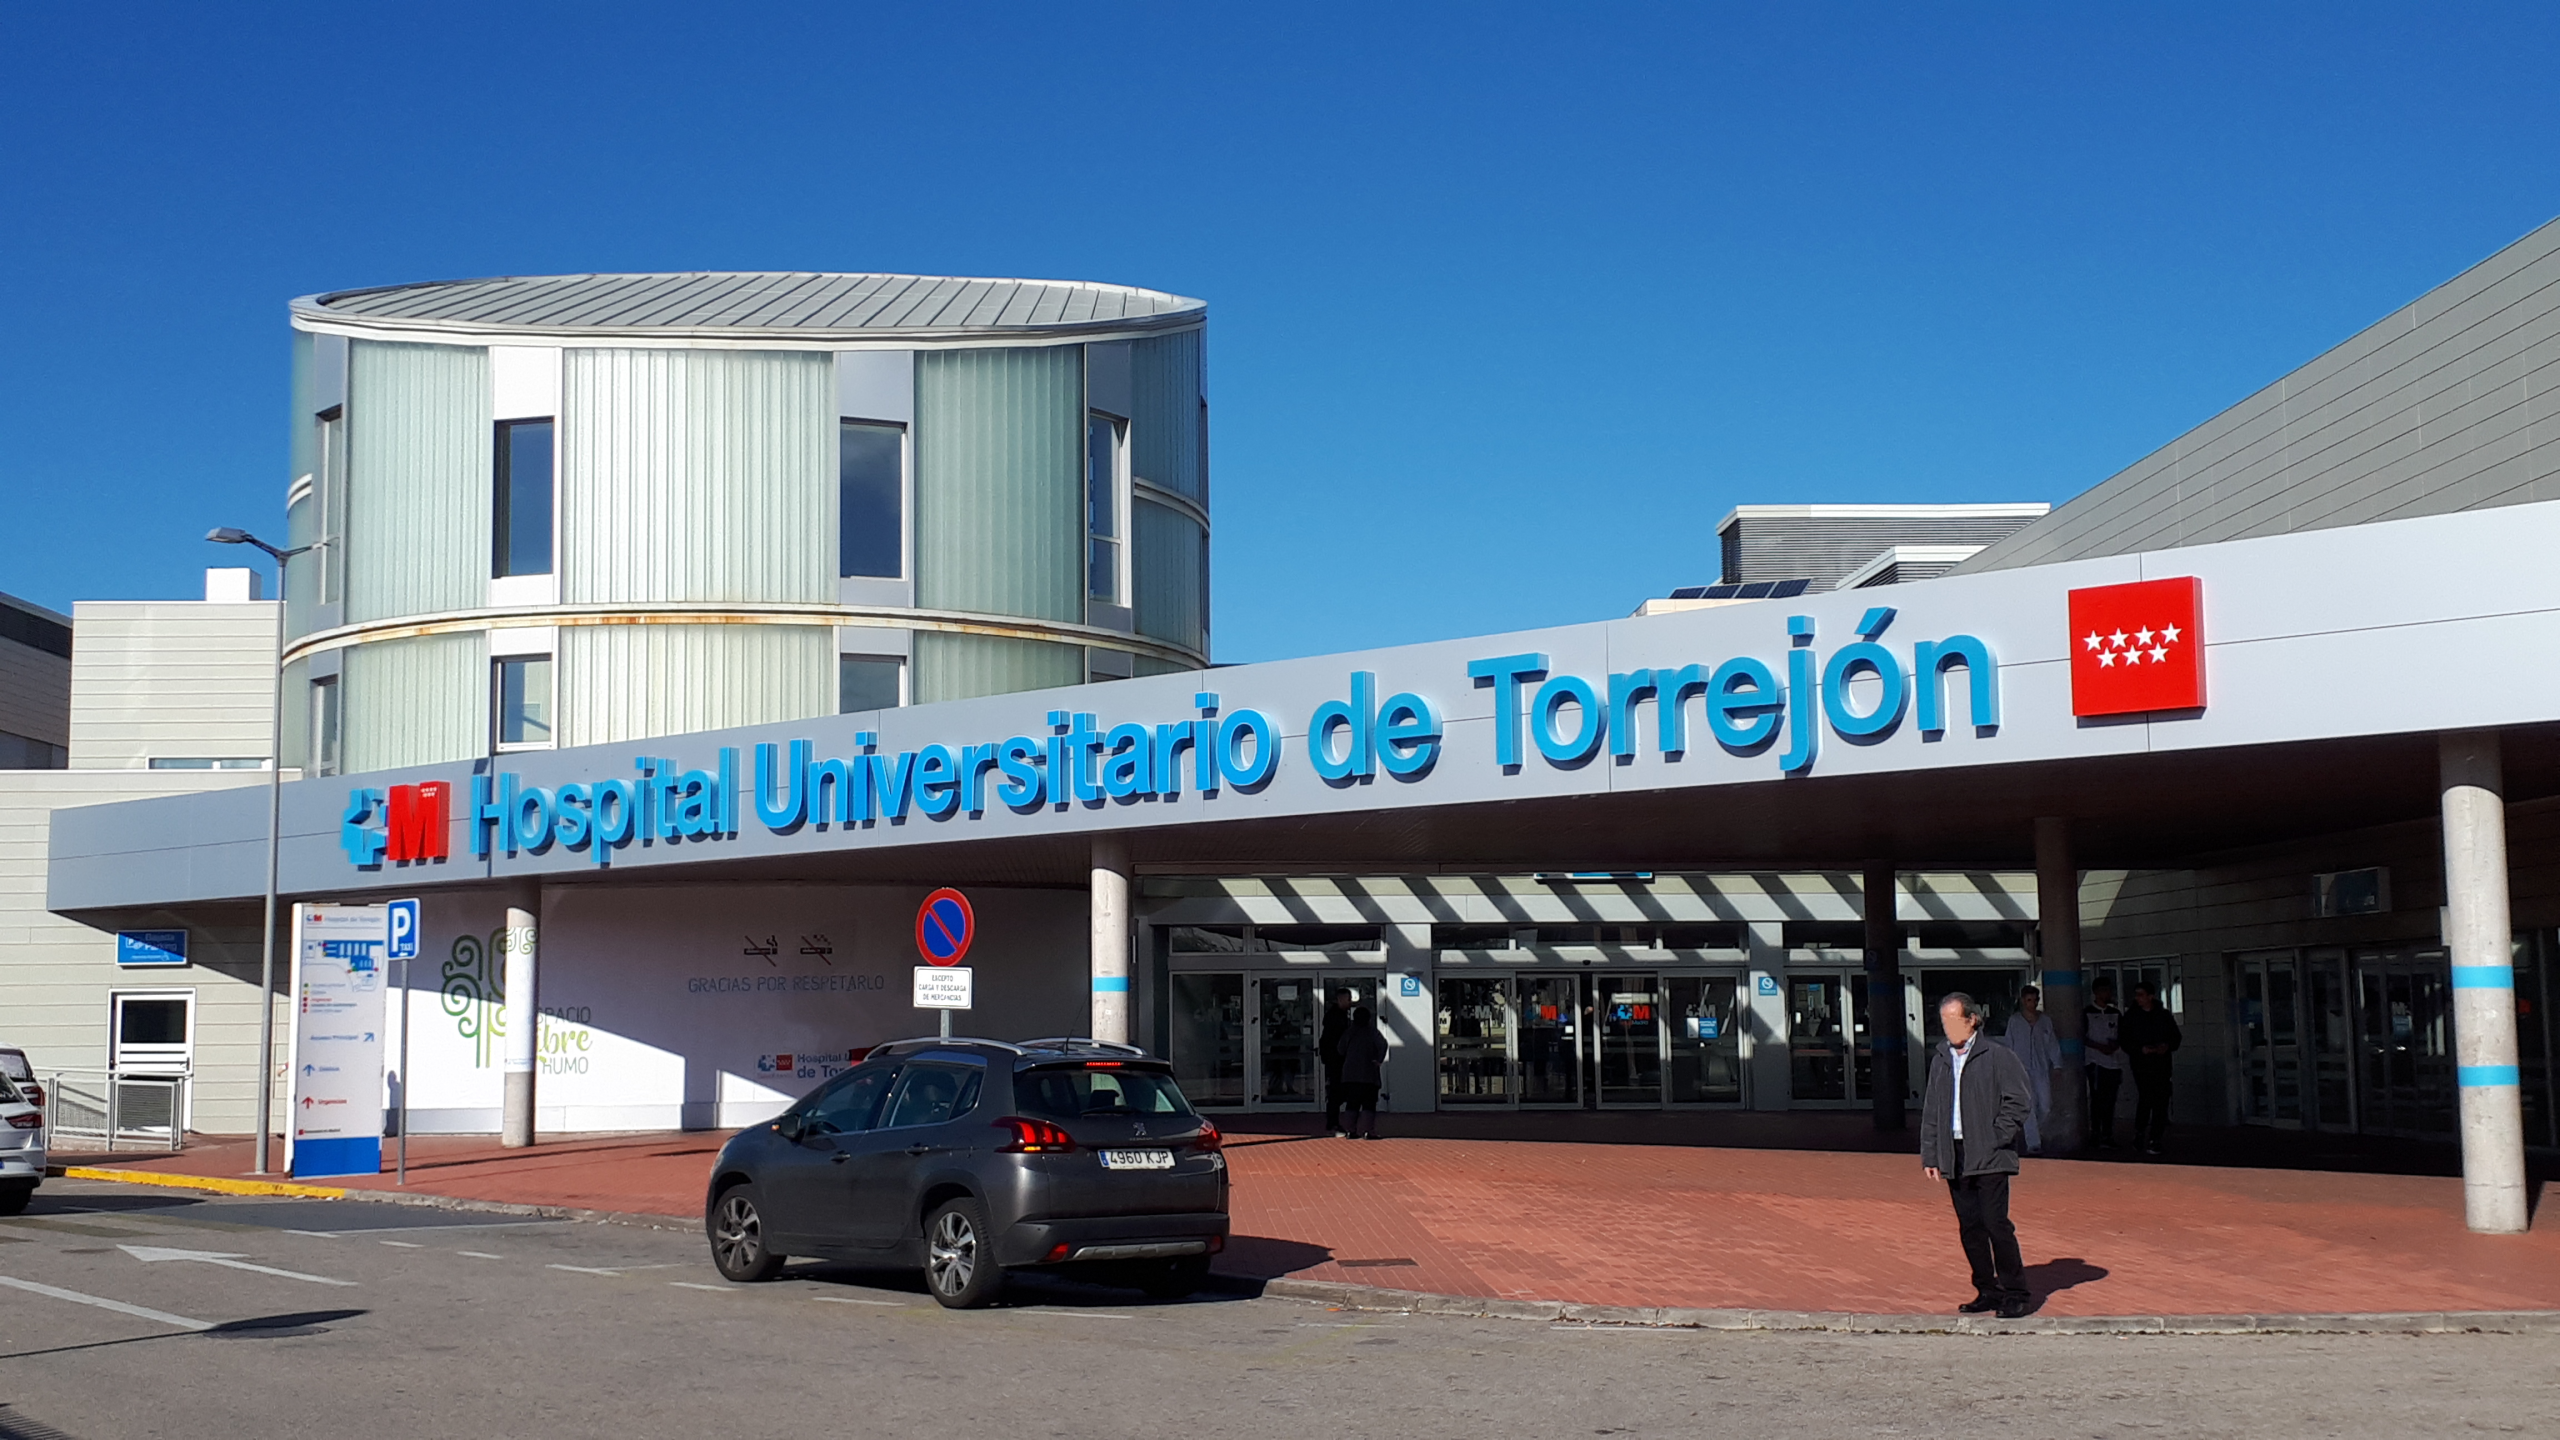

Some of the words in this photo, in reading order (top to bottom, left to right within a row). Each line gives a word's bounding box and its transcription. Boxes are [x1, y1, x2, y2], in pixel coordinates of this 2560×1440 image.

[470, 747, 739, 864] Hospital
[755, 692, 1281, 830] Universitario
[1308, 671, 1442, 776] de
[1467, 606, 1999, 771] Torrejón
[392, 907, 411, 952] P
[688, 977, 751, 993] GRACIAS
[757, 976, 786, 991] POR
[793, 975, 884, 991] RESPETARLO
[537, 1006, 591, 1024] SPACIO
[1633, 1004, 1649, 1020] M
[542, 1056, 589, 1075] HUMO
[797, 1054, 840, 1063] Hospital
[797, 1065, 816, 1079] de
[1110, 1151, 1143, 1164] 4960
[1146, 1151, 1169, 1164] KJP
